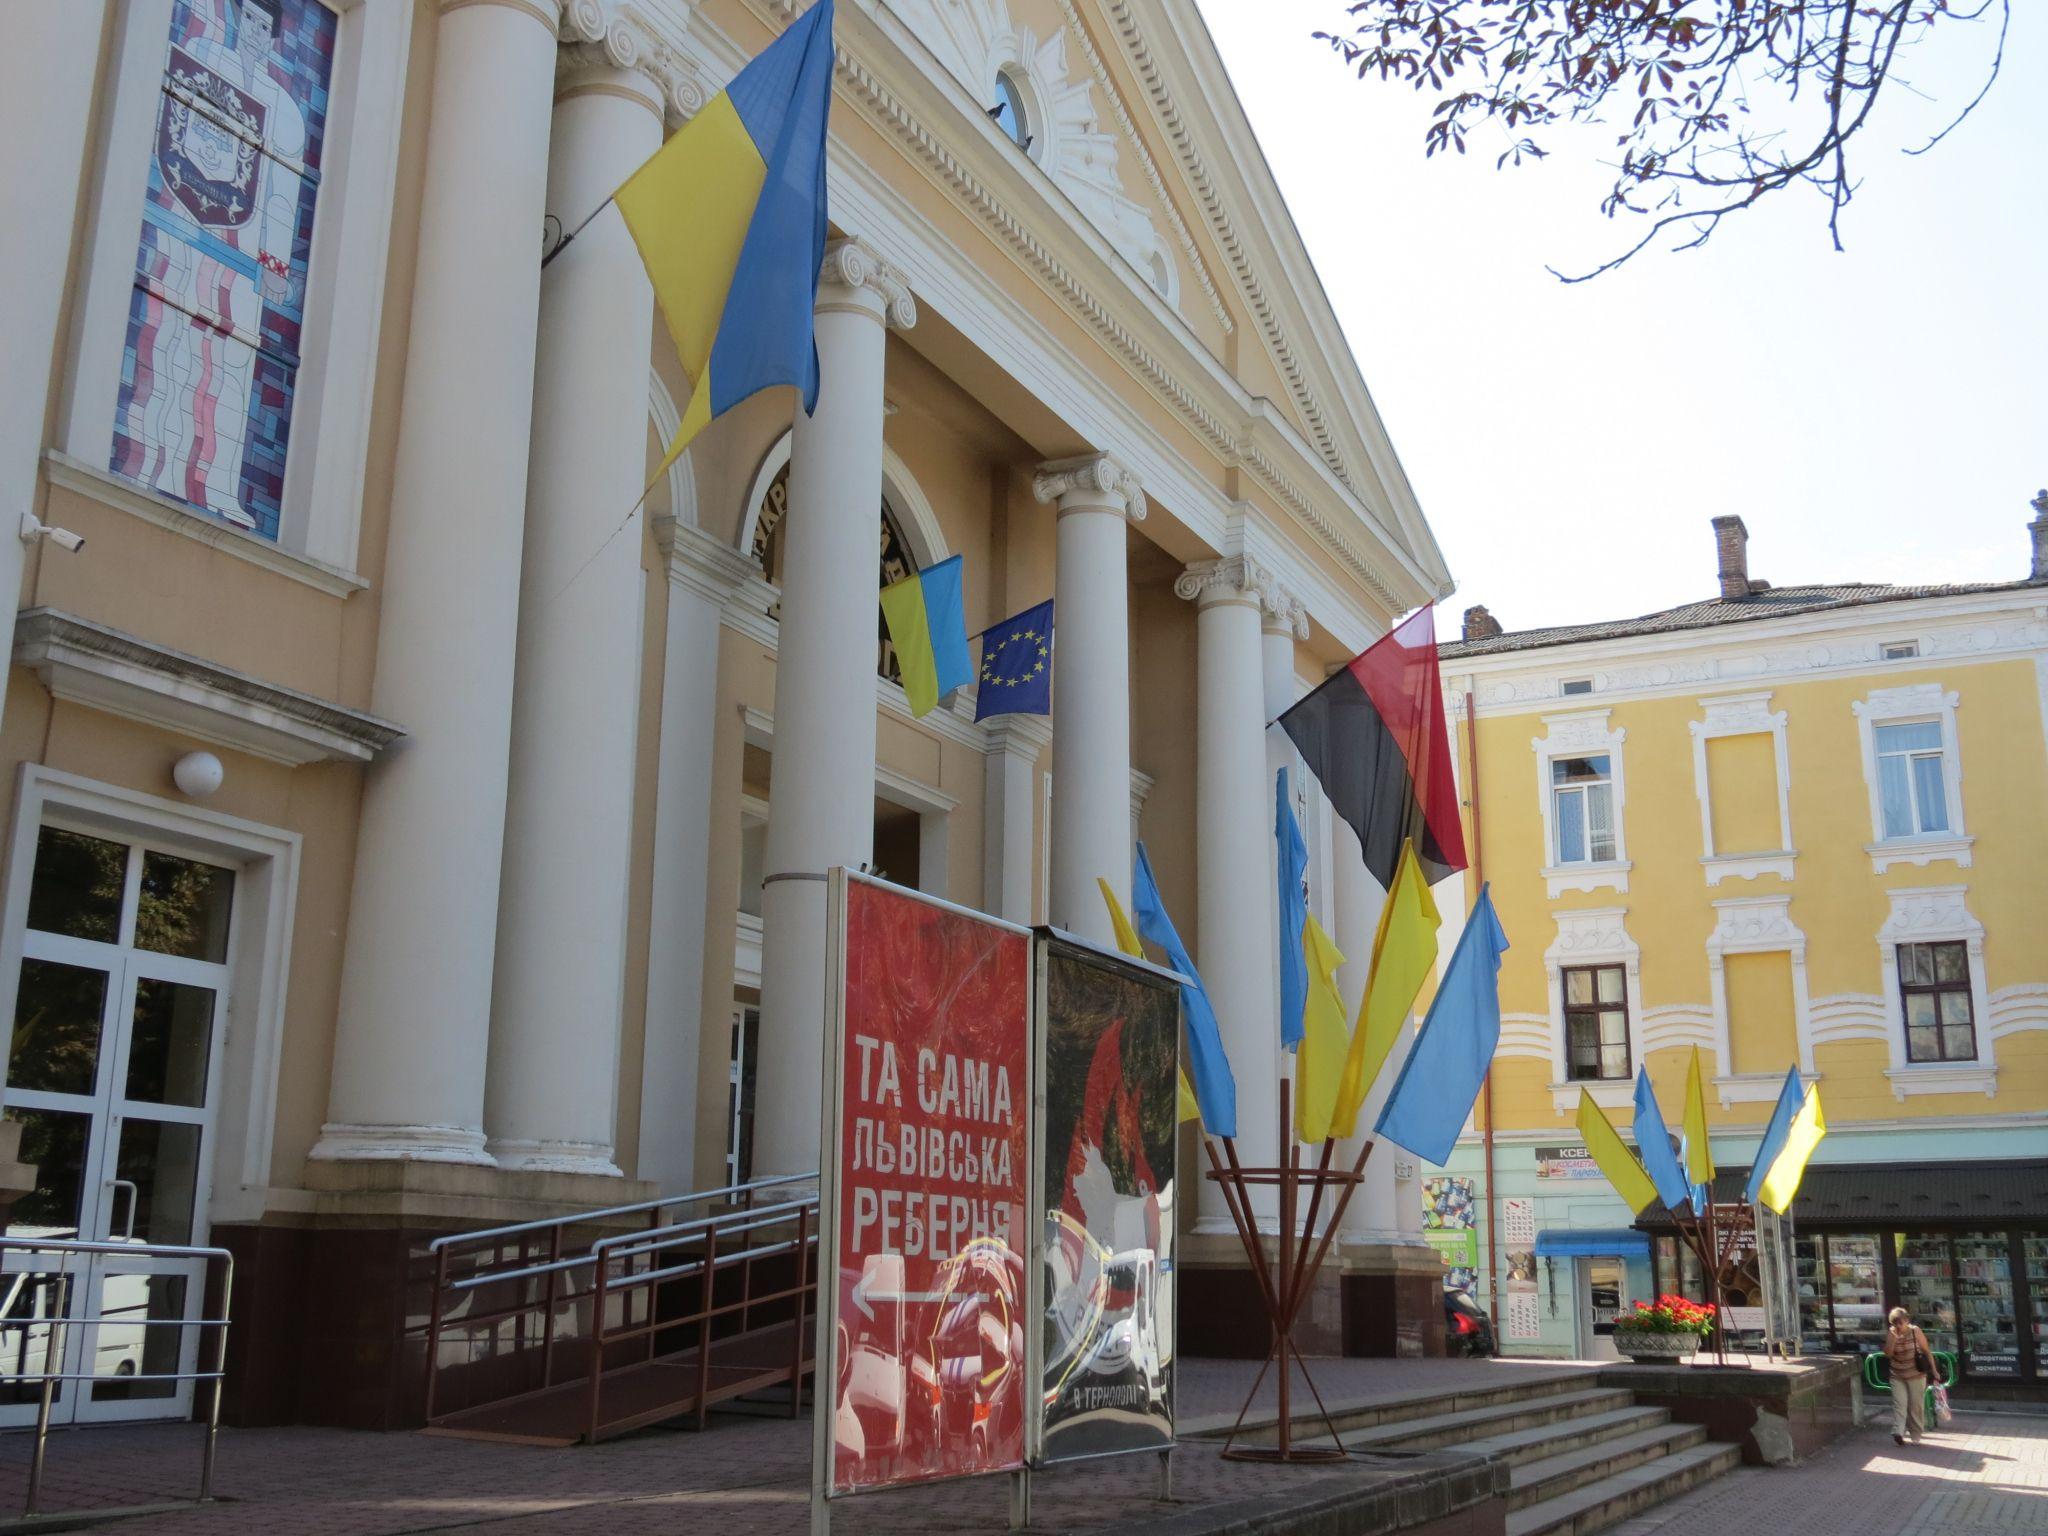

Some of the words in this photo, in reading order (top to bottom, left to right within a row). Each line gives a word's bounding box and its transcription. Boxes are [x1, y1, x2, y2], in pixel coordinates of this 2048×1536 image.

[855, 1033, 902, 1108] ТА
[918, 1048, 1013, 1127] САМА
[853, 1117, 1013, 1187] ЛЬВІВСЬКА
[1556, 1160, 1598, 1168] КОСМЕТИ
[852, 1186, 1010, 1262] РЕБЕРНЯ
[1073, 1387, 1081, 1409] В
[1085, 1384, 1137, 1409] ТЕРНОПОЛІ
